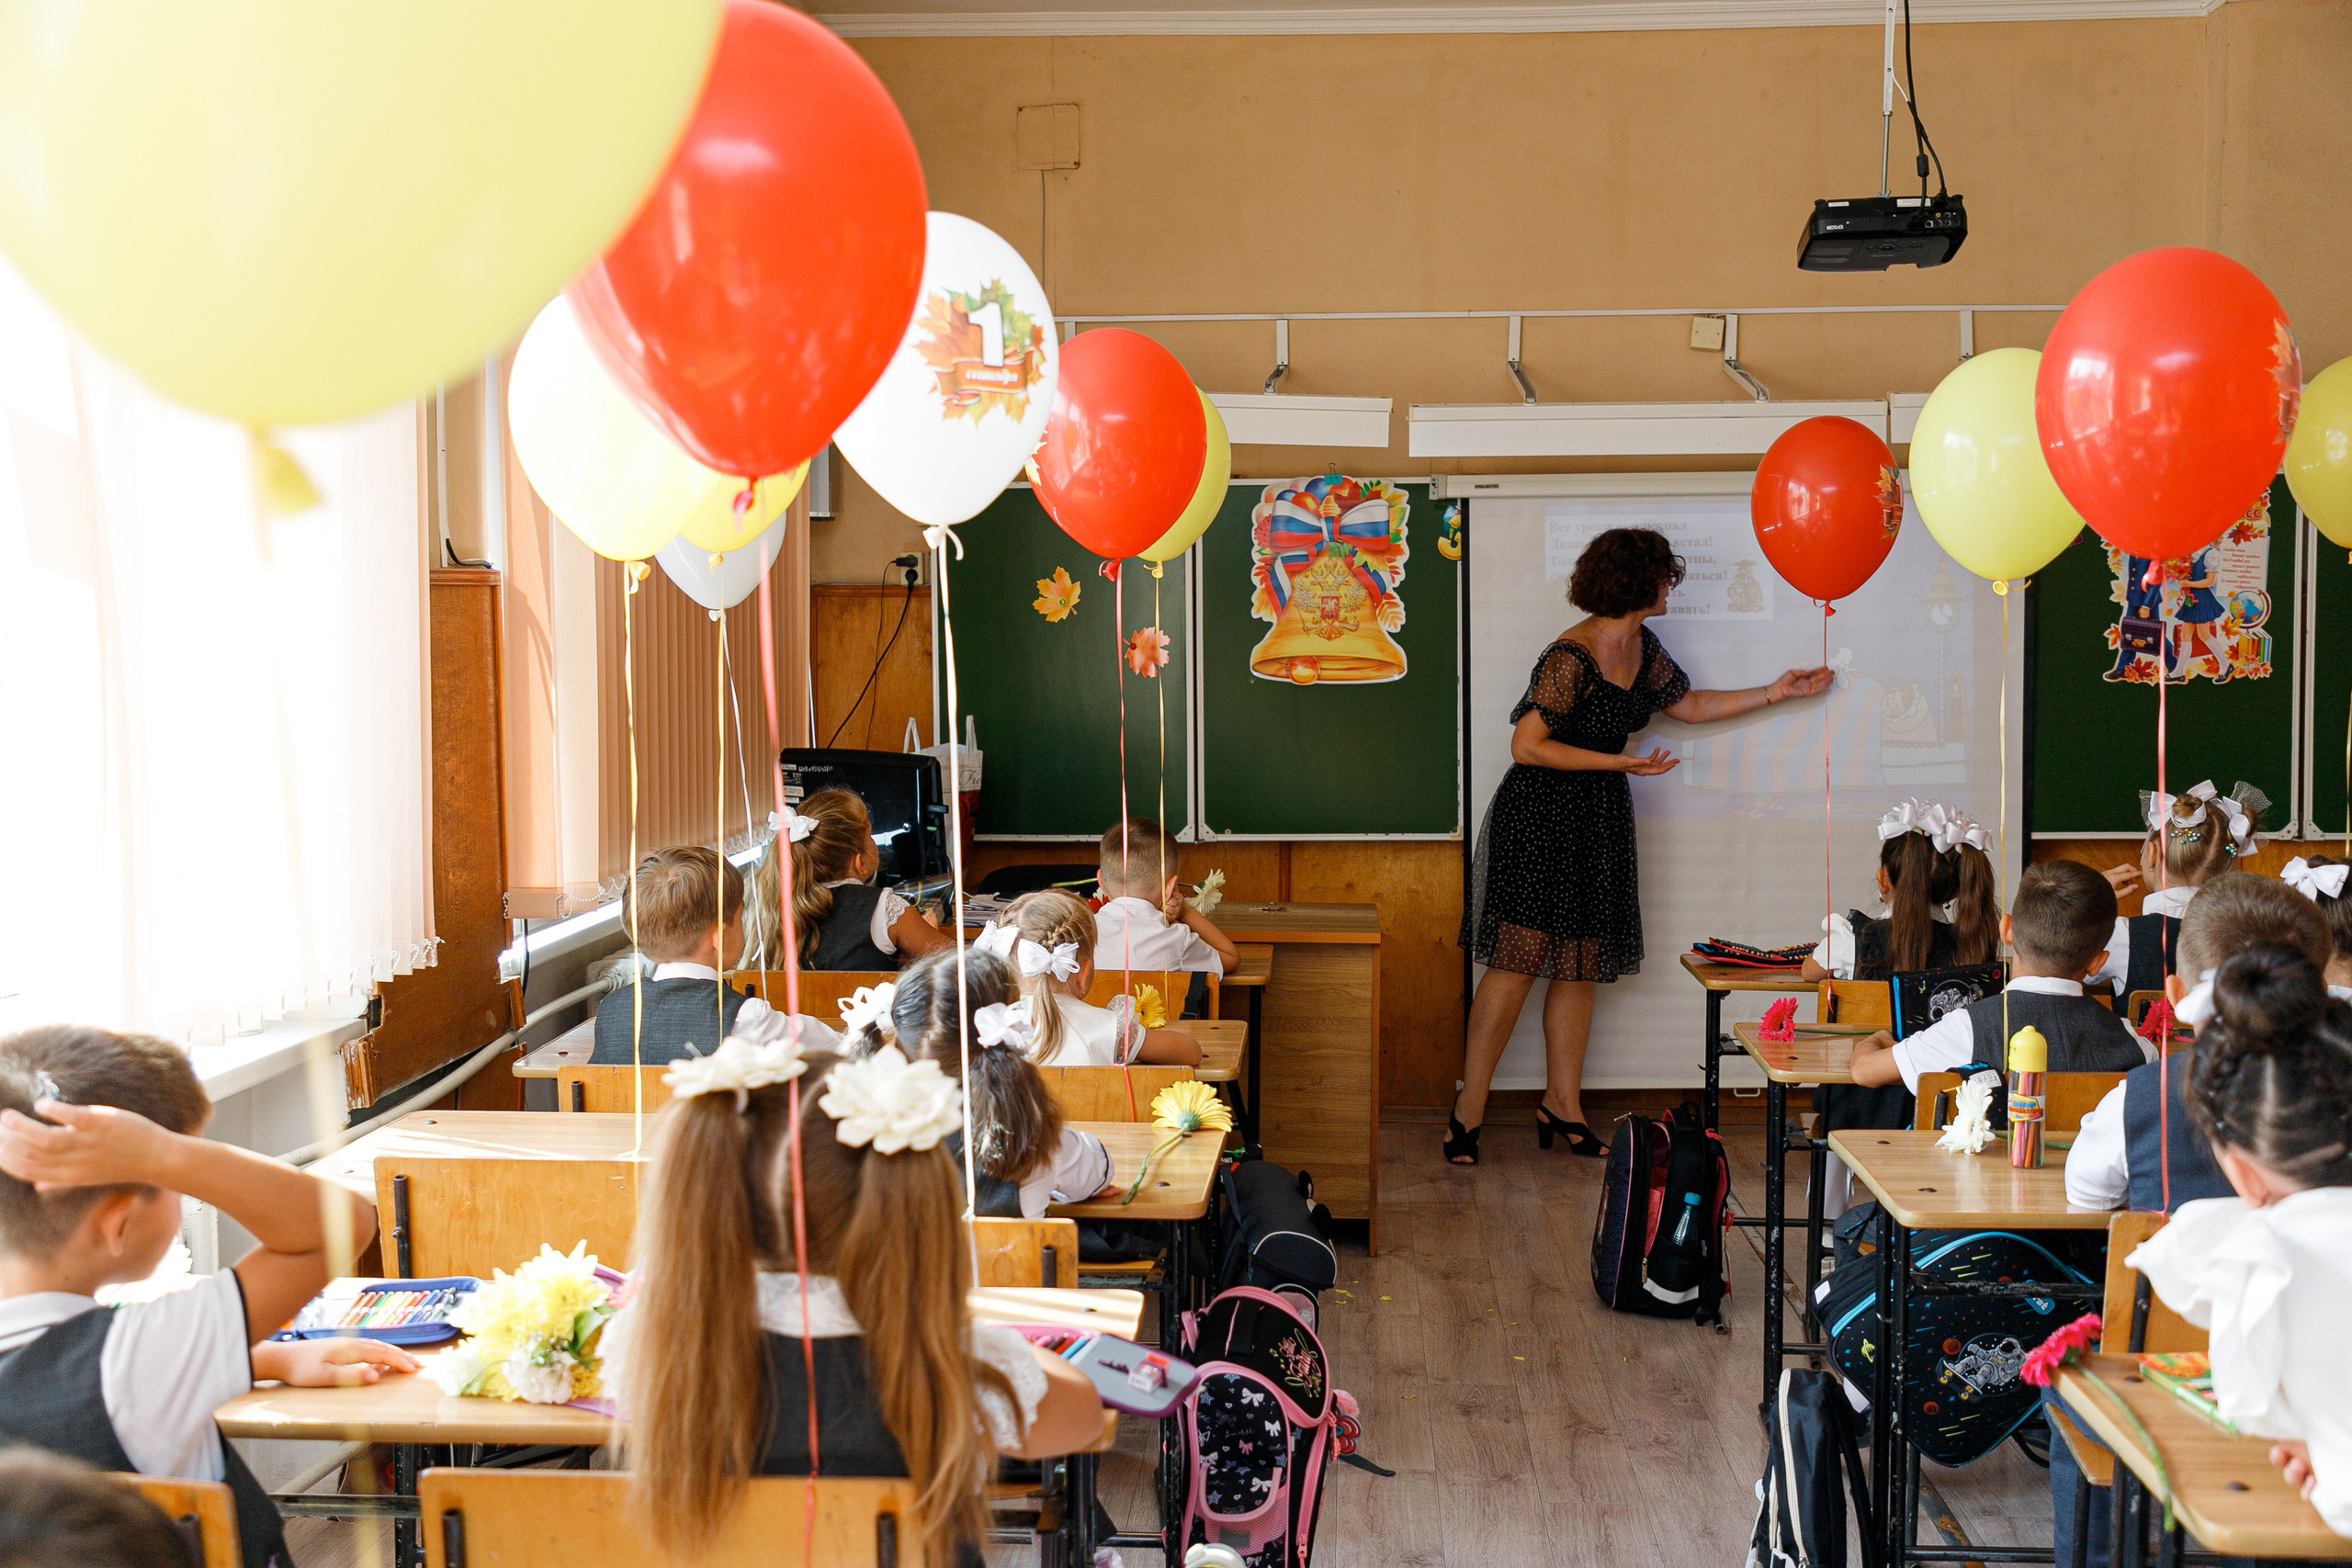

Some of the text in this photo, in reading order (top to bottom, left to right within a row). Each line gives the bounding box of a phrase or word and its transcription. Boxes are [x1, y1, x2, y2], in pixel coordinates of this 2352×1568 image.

[968, 301, 1004, 367] 1
[2245, 508, 2261, 519] сс
[1549, 522, 1571, 532] Все
[1673, 536, 1713, 547] встал!
